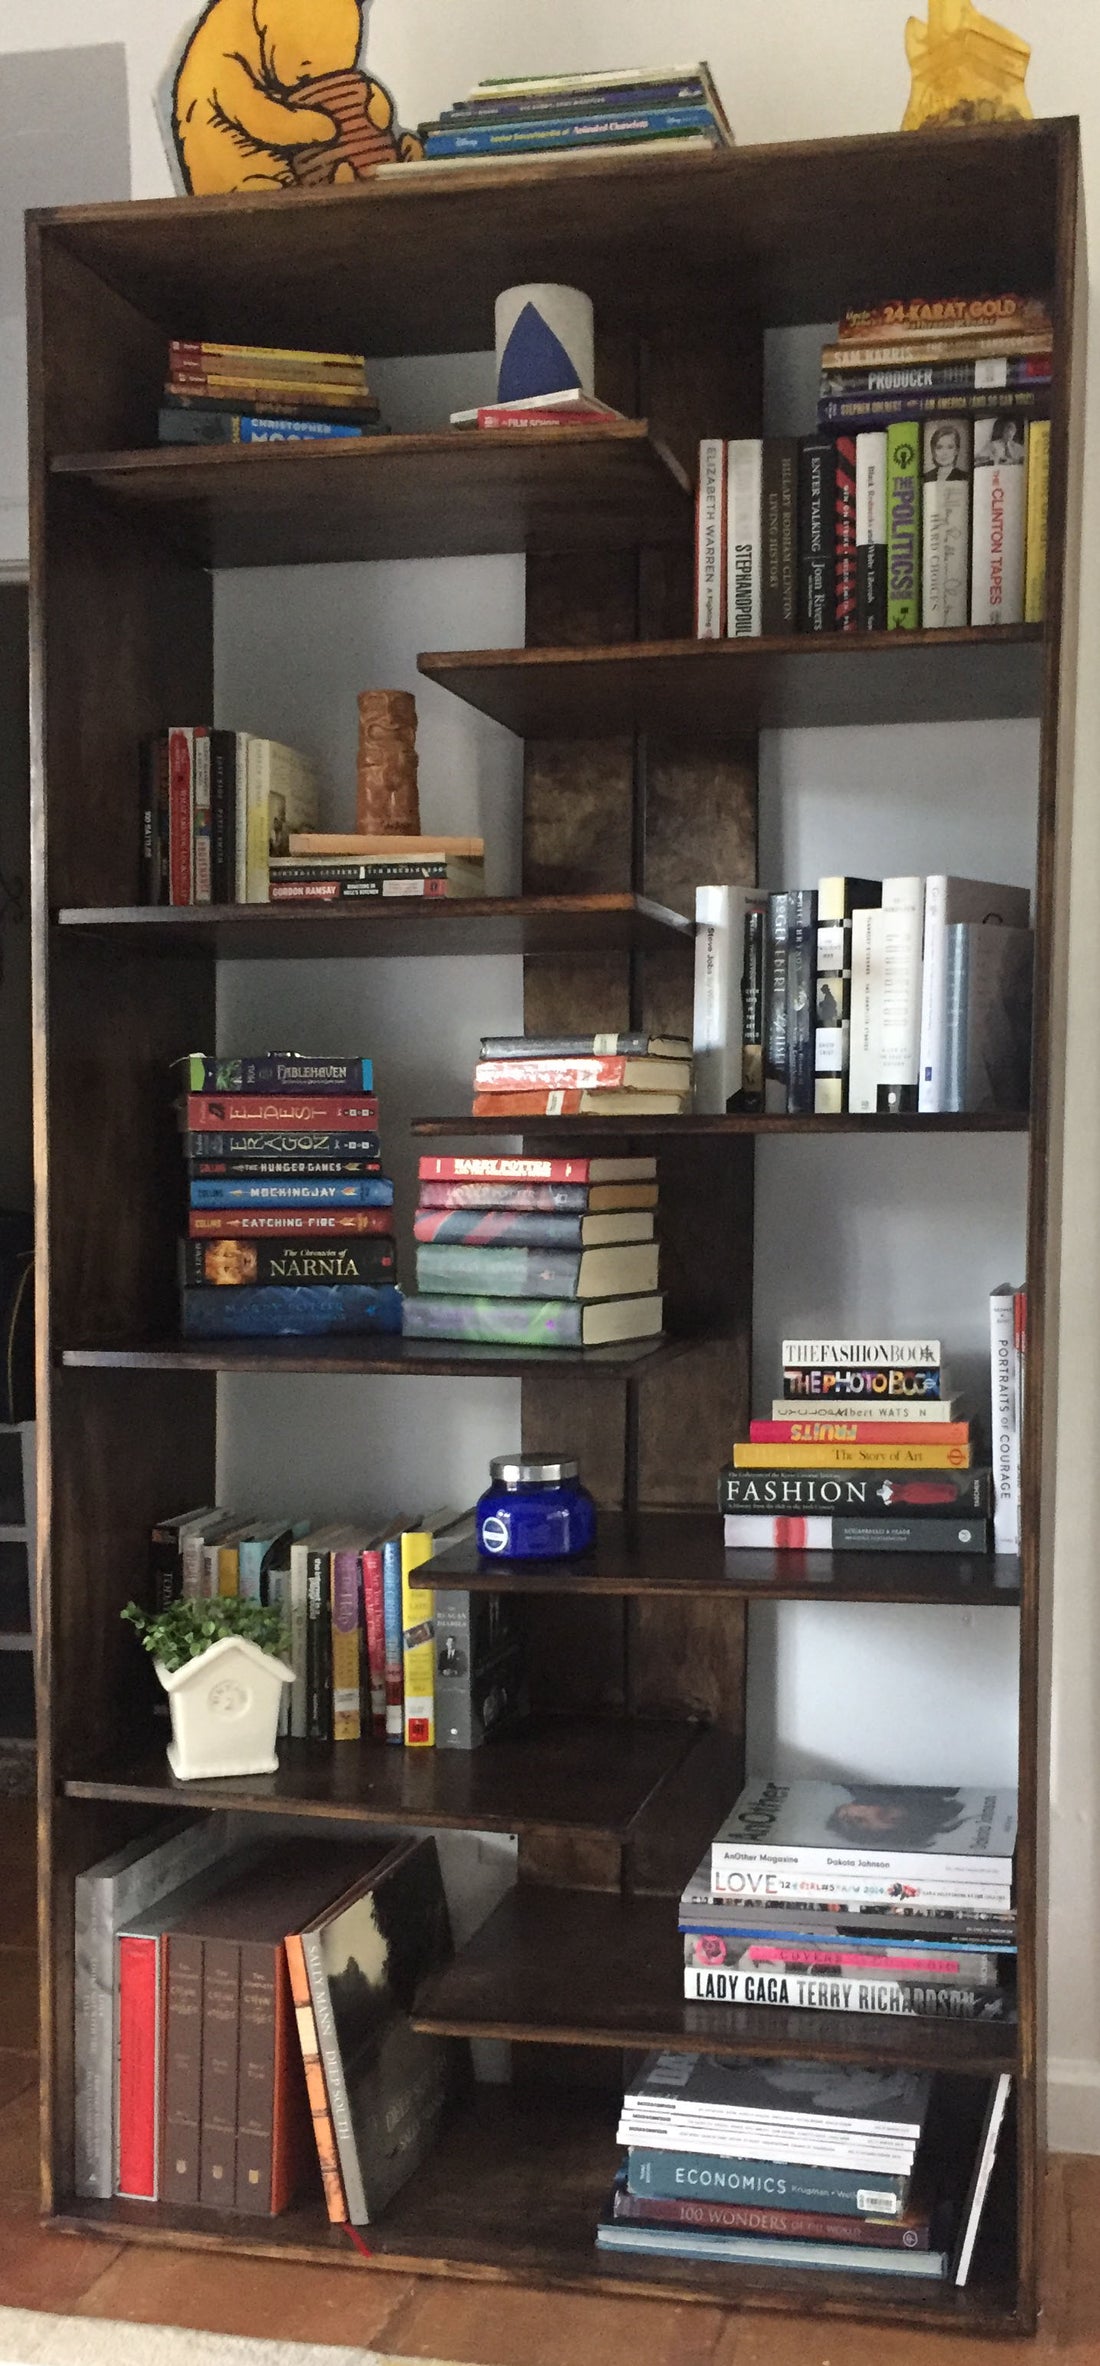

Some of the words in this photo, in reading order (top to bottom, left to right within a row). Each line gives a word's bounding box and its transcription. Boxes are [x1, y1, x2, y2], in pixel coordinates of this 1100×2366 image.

[969, 298, 1017, 318] GOLD
[868, 368, 933, 390] PRODUCER
[251, 418, 331, 434] CHRISTOPHER
[705, 447, 717, 520] ELIZABETH
[781, 457, 791, 506] HILLARY
[810, 456, 821, 497] ENTER
[781, 512, 792, 563] RODHAM
[810, 498, 821, 553] TALKING
[929, 513, 942, 552] HARD
[990, 488, 1004, 554] CLINTON
[705, 525, 715, 583] WARREN
[891, 490, 914, 592] POLITICS
[769, 538, 779, 589] HISTORY
[810, 561, 826, 590] Joan
[989, 556, 1003, 605] TAPES
[782, 567, 792, 621] CLINTON
[929, 554, 941, 612] CHOICES
[812, 593, 826, 631] Rivers
[272, 886, 304, 897] GORDON
[304, 885, 337, 896] RAMSAY
[774, 894, 788, 946] ROGER
[706, 927, 716, 952] Steve
[706, 953, 716, 976] Jobs
[773, 949, 786, 993] EBERT
[277, 1064, 347, 1080] FABLEHAVEN
[230, 1104, 328, 1120] ELDEST
[229, 1135, 330, 1152] ERAGON
[260, 1163, 305, 1172] HUNGER
[307, 1162, 342, 1172] GAMES
[250, 1187, 336, 1197] MOCKINGJAY
[241, 1218, 303, 1228] CATCHING
[308, 1218, 336, 1227] FIRE
[270, 1258, 360, 1277] NARNIA
[284, 1249, 298, 1257] The
[300, 1249, 337, 1258] Chronicles
[338, 1249, 349, 1258] of
[998, 1339, 1010, 1413] PORTRAITS
[1000, 1416, 1009, 1430] OF
[832, 1449, 855, 1460] The
[858, 1450, 892, 1463] Story
[892, 1450, 904, 1462] of
[905, 1450, 923, 1462] Art
[999, 1434, 1011, 1500] COURAGE
[726, 1480, 867, 1503] FASHION
[723, 1851, 758, 1863] AnOther
[826, 1857, 856, 1868] Dakota
[858, 1858, 891, 1870] Johnson
[714, 1871, 779, 1895] LOVE
[306, 1945, 326, 1986] SALLY
[315, 1990, 333, 2036] MANN
[696, 1972, 739, 2000] LADY
[744, 1975, 790, 2004] GAGA
[796, 1979, 853, 2009] TERRY
[858, 1983, 976, 2018] RICHARDSON
[325, 2049, 341, 2087] DEEP
[333, 2089, 350, 2140] SOUTH
[674, 2167, 787, 2195] ECONOMICS
[679, 2205, 704, 2220] 100
[708, 2208, 788, 2232] WONDERS
